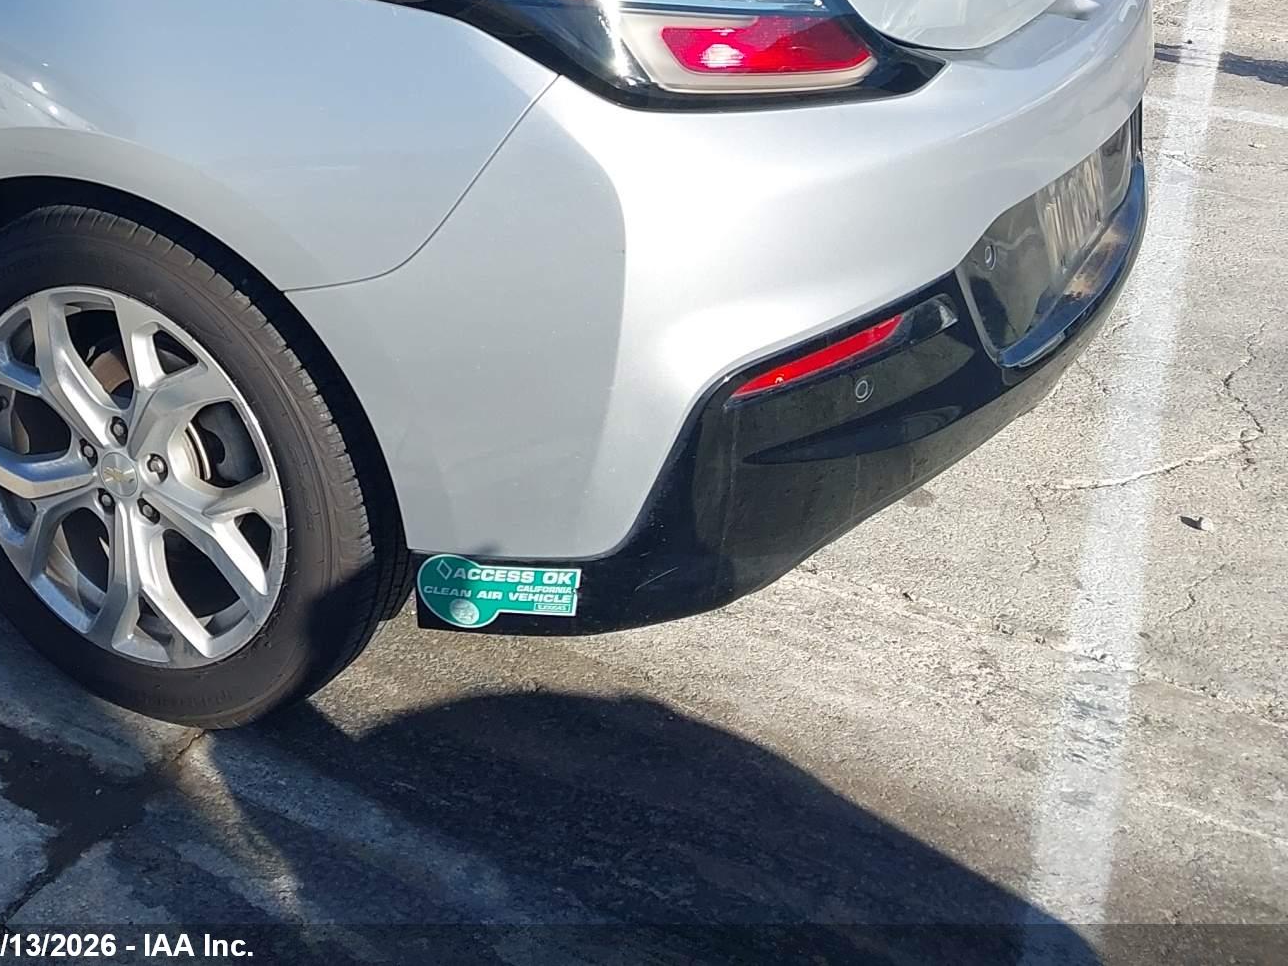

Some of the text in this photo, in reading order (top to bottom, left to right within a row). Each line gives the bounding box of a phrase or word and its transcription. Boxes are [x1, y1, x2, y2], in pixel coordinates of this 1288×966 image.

[452, 568, 575, 585] ACCESS OK
[423, 585, 573, 604] CLEAN AIR VEHICLE
[516, 585, 573, 594] CALIFORNIA
